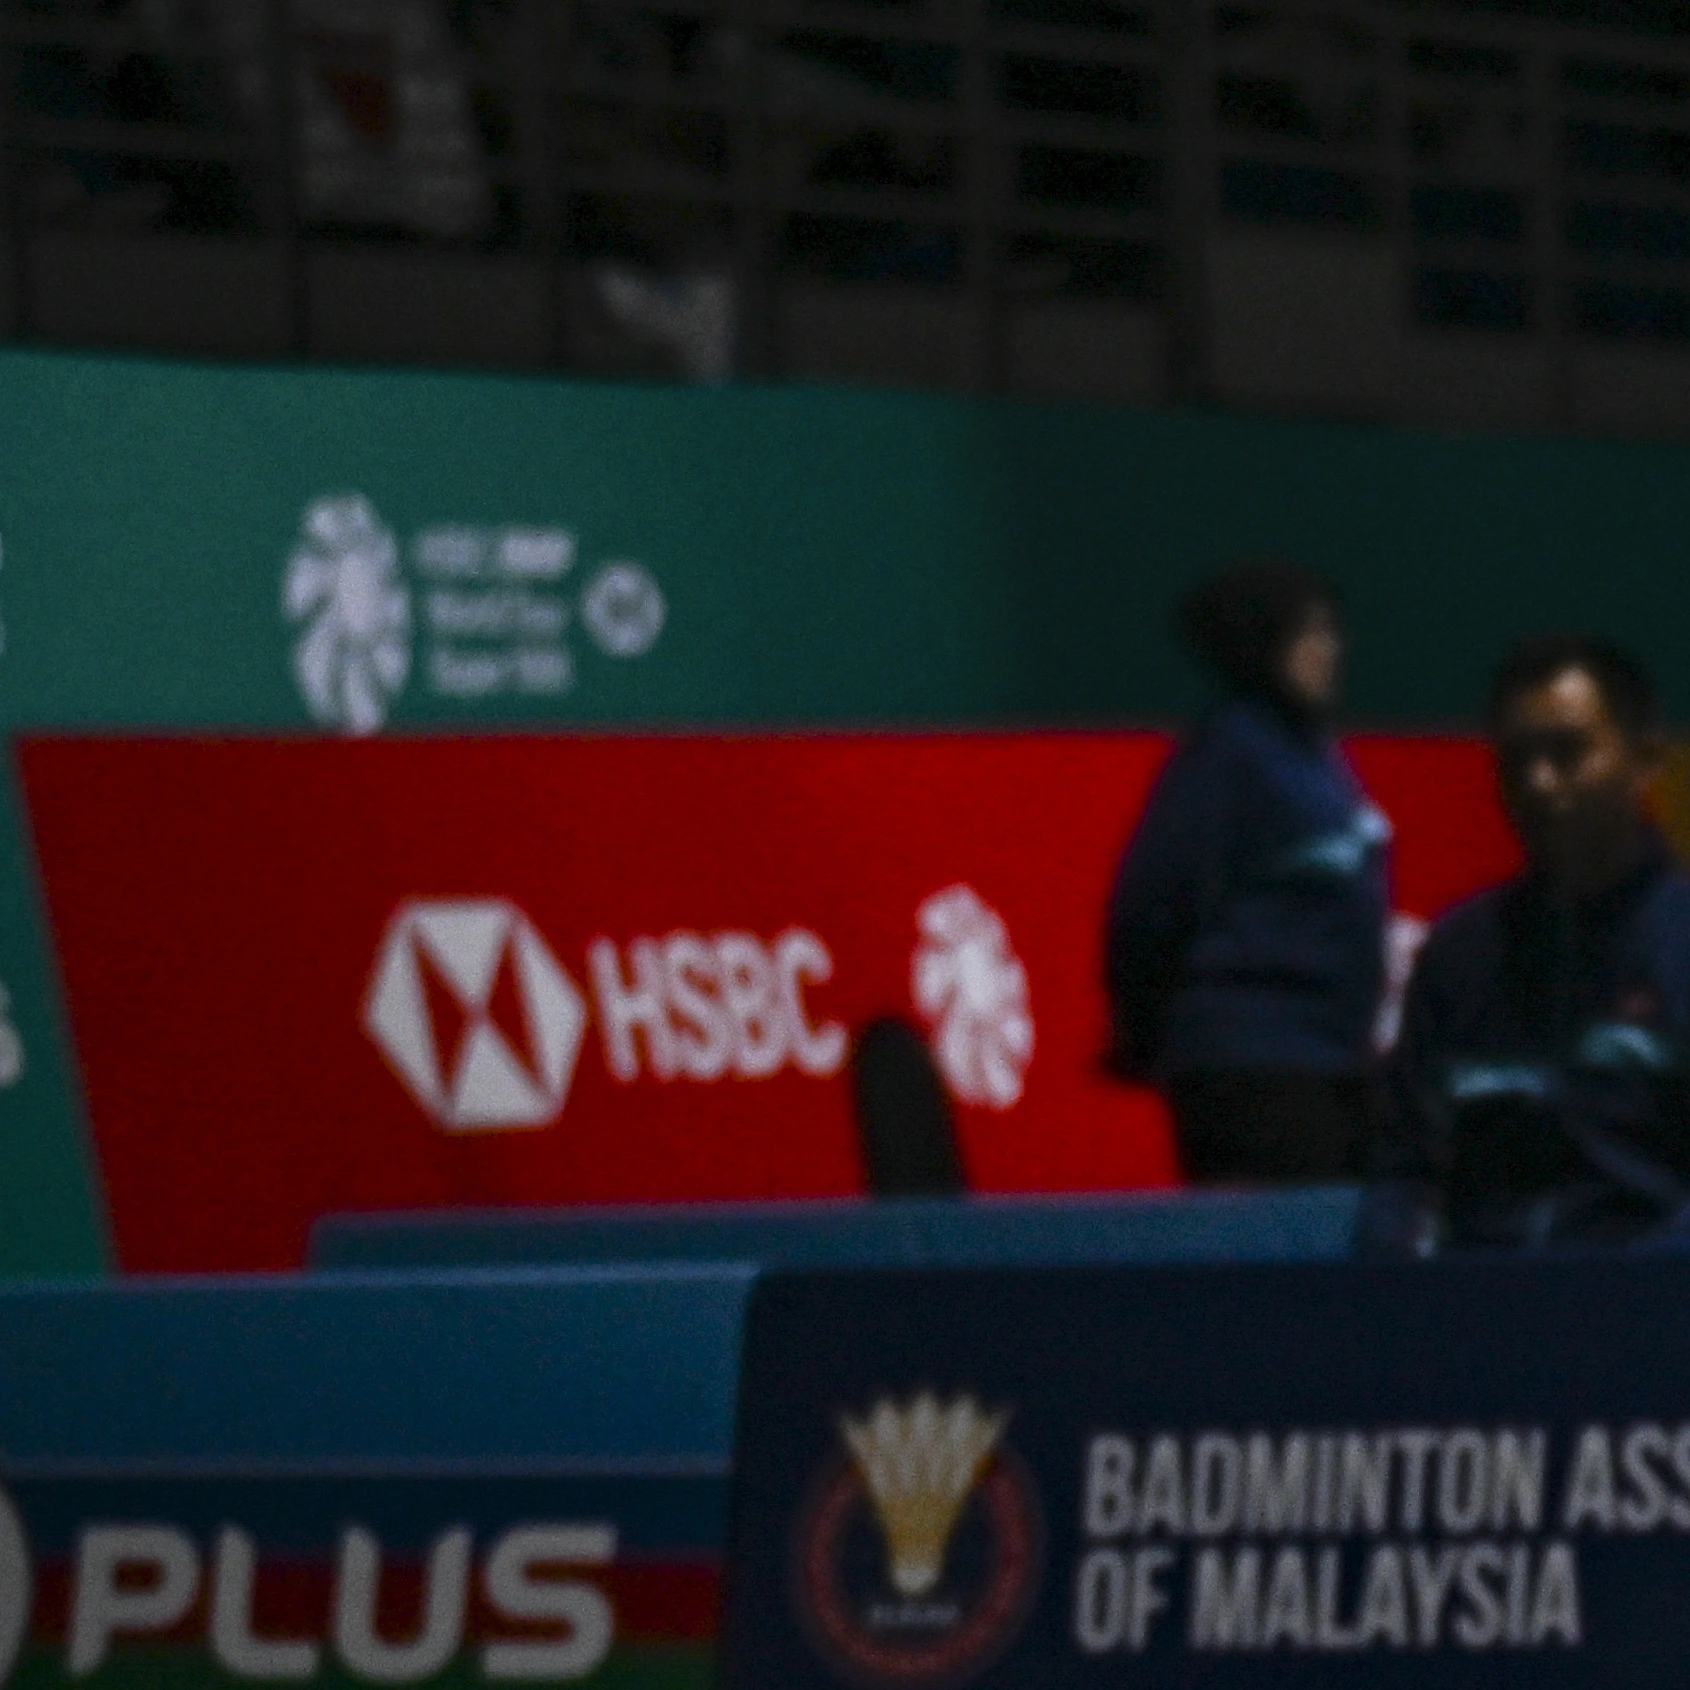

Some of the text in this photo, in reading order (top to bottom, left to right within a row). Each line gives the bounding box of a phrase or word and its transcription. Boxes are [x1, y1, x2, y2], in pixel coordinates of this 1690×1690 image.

[590, 930, 846, 1080] HSBC
[1087, 1427, 1547, 1536] BADMINTON
[67, 1522, 619, 1681] PLUS
[1077, 1540, 1582, 1653] OF MALAYSIA
